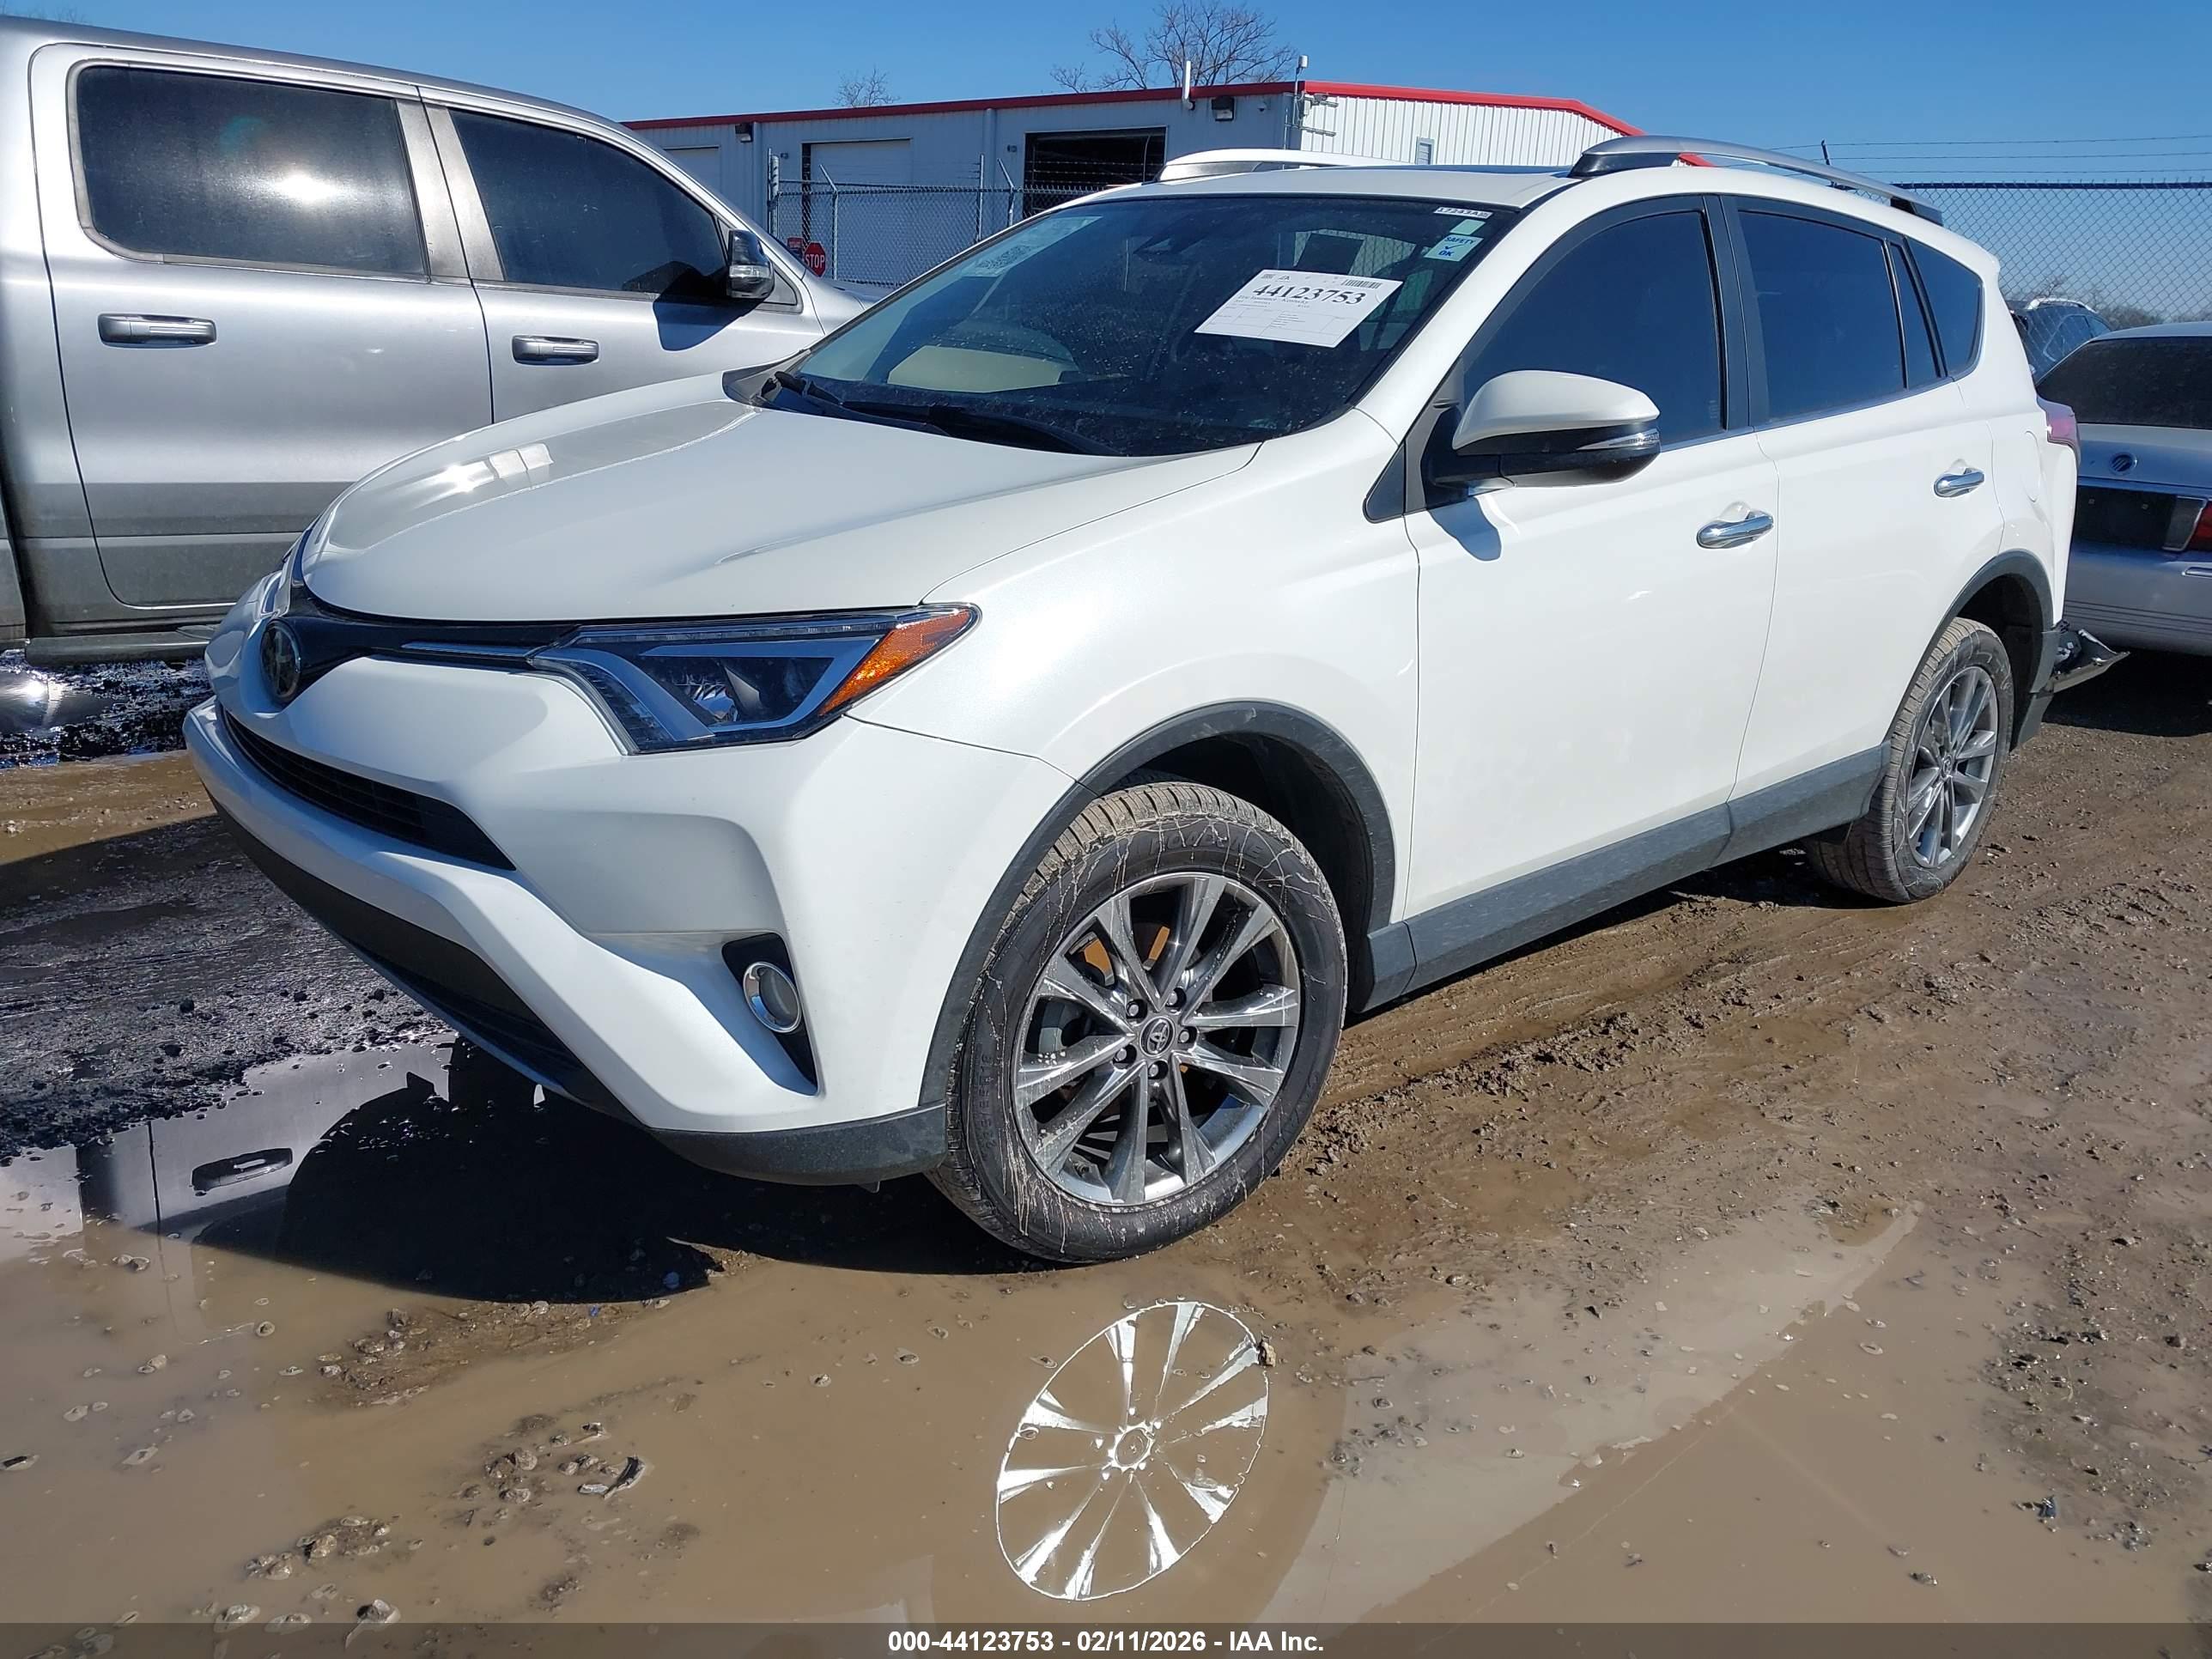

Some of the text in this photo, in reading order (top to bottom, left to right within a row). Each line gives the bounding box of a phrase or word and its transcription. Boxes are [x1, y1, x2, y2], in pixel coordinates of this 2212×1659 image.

[1444, 236, 1477, 245] SAFETY
[805, 253, 825, 269] STOP
[1253, 284, 1367, 305] 44123753
